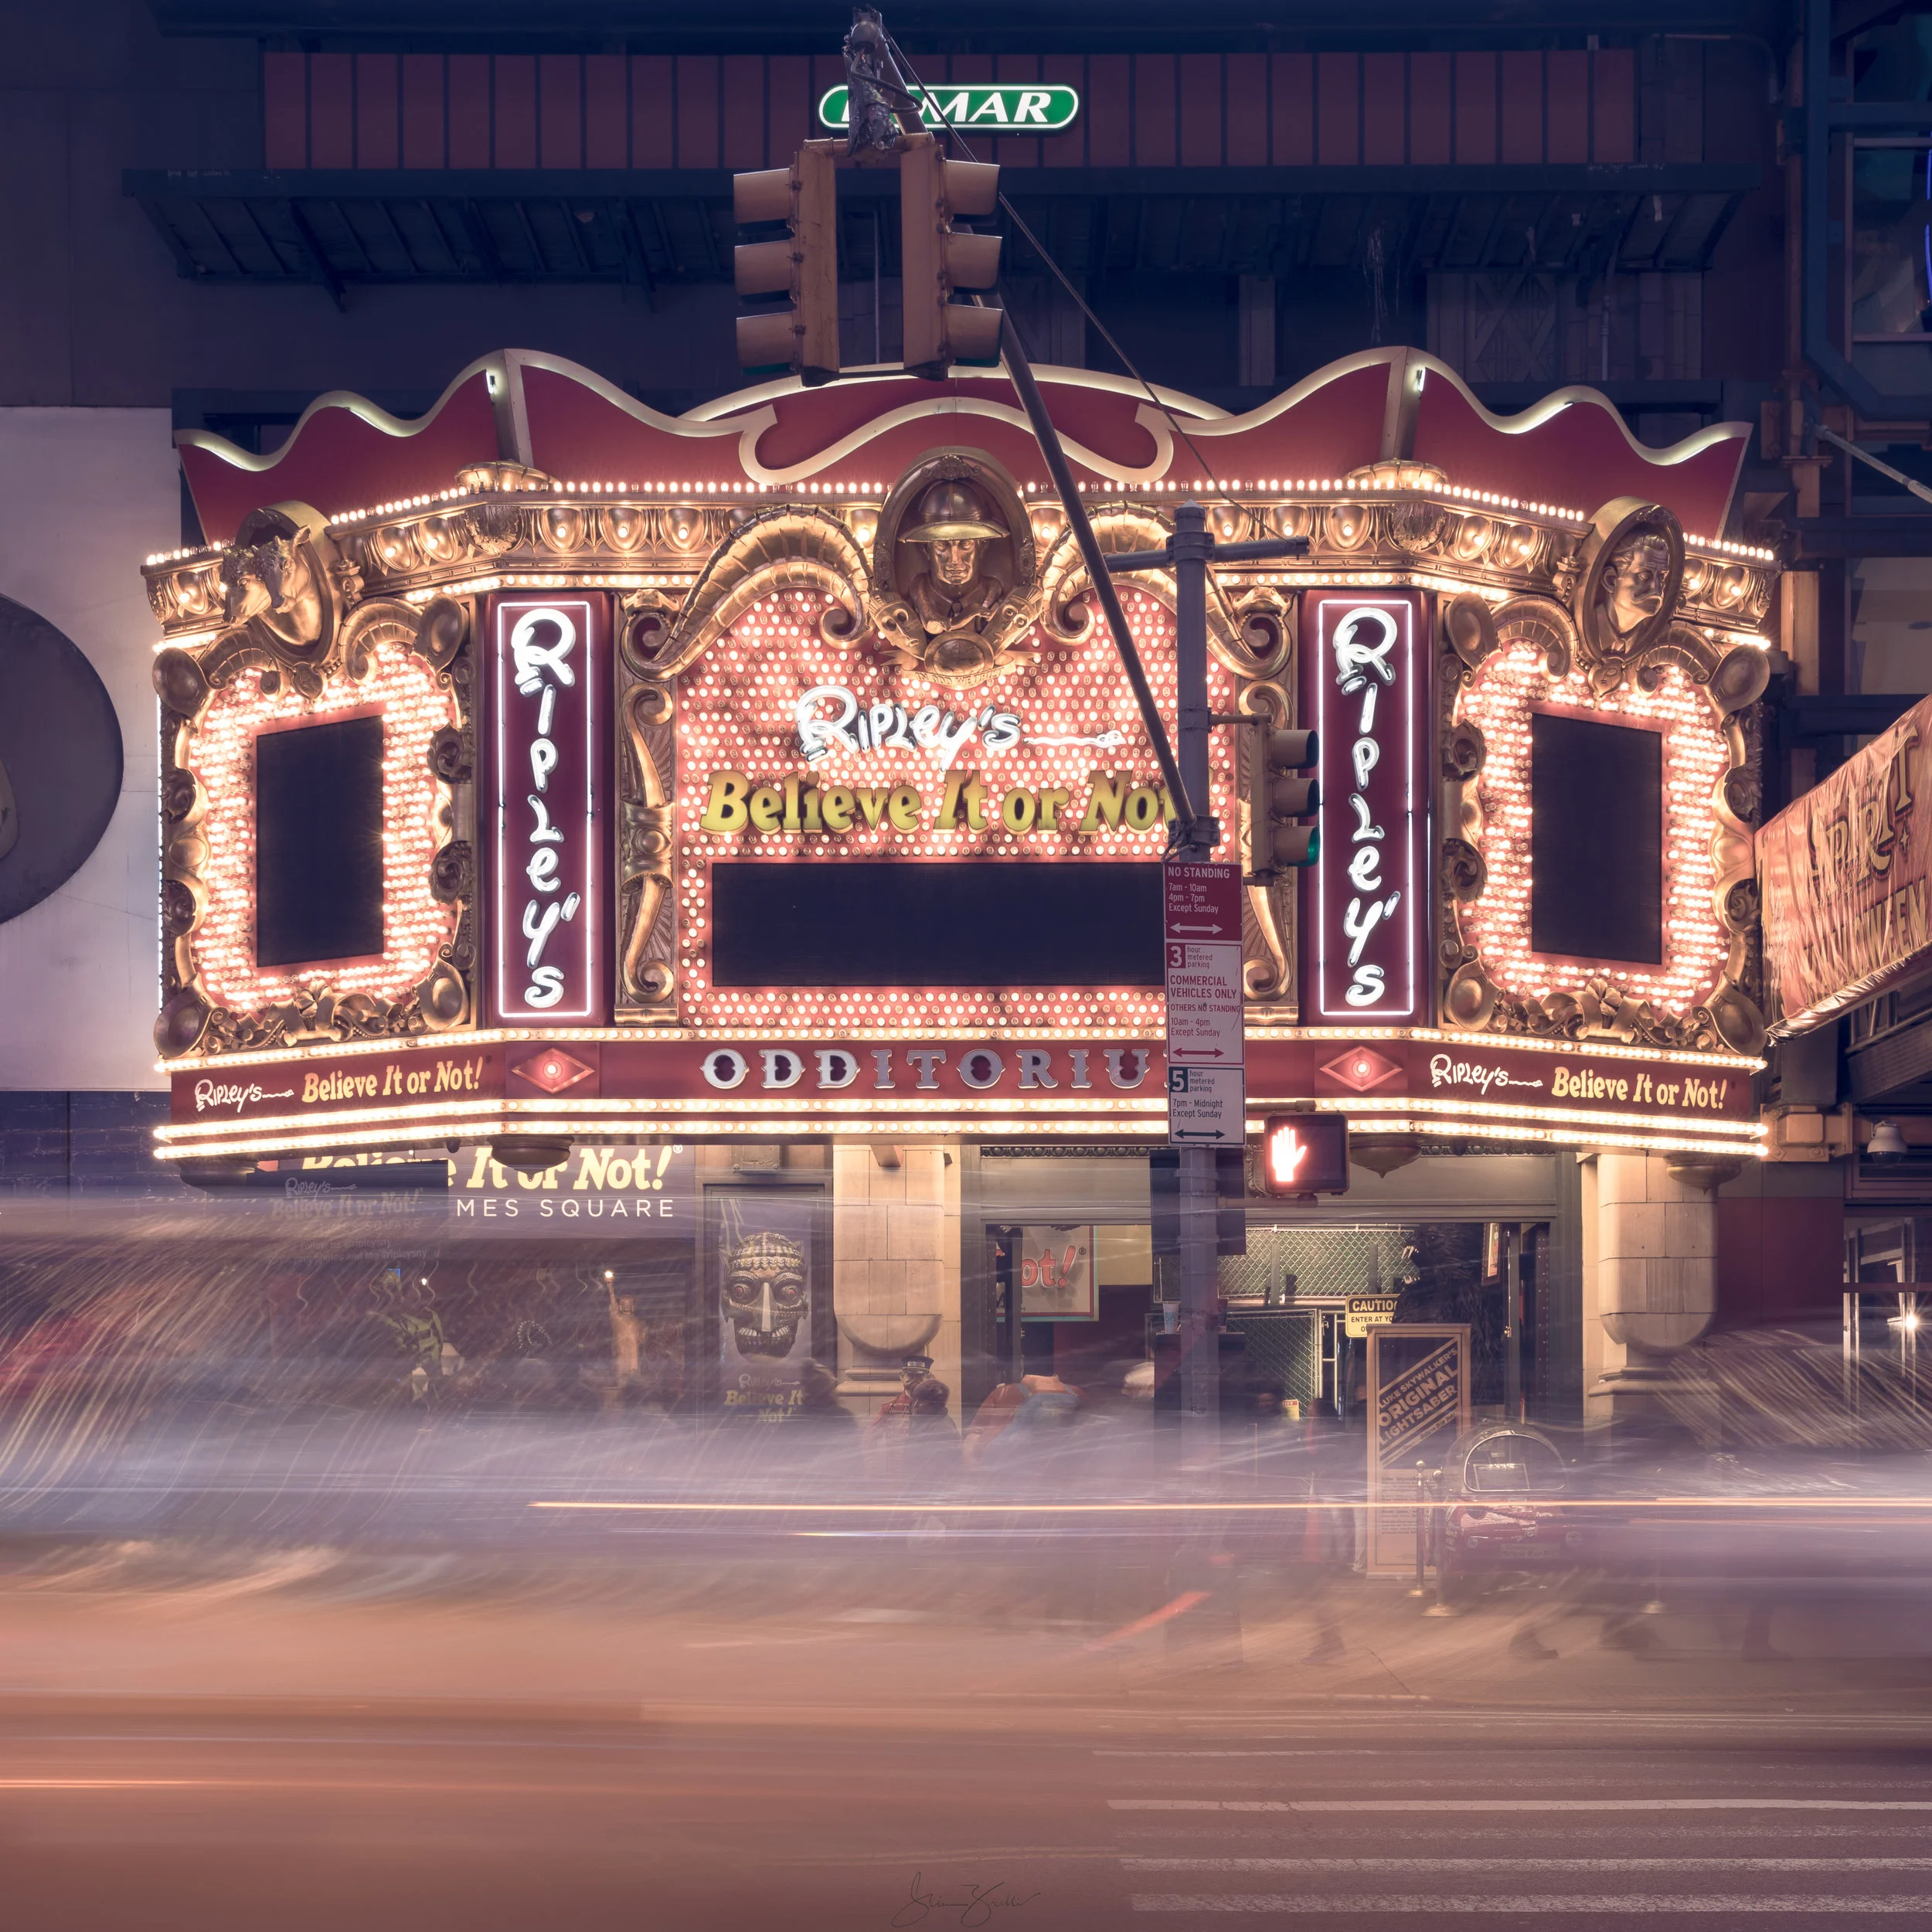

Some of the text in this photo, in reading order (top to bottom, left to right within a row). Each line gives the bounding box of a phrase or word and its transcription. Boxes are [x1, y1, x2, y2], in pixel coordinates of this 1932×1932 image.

[842, 91, 1051, 122] MAR
[794, 685, 1022, 773] Ripley's
[511, 608, 580, 1009] Ripley's
[699, 770, 1177, 833] Believe It or No
[1332, 607, 1402, 1007] Ripley's
[1168, 866, 1230, 879] NO STANDING
[1168, 883, 1182, 892] 7am
[1189, 883, 1207, 893] 10am
[1168, 893, 1184, 903] 4pm
[1191, 893, 1205, 903] 7pm
[1168, 903, 1219, 914] Except Sunday
[1170, 945, 1182, 967] 3
[1187, 961, 1210, 969] parking
[1170, 975, 1227, 986] COMMERCIAL
[1171, 988, 1236, 998] VEHICLES ONLY
[1171, 1003, 1196, 1012] OTHERS
[1209, 1004, 1240, 1013] STANDING
[1171, 1017, 1189, 1026] 10am
[1196, 1018, 1210, 1028] 4pm
[1171, 1028, 1220, 1038] Except Sunday
[699, 1047, 1168, 1089] ODDITORIU
[194, 1056, 483, 1114] Ripley's Believe It or Not!
[1172, 1070, 1184, 1092] 5
[1189, 1084, 1212, 1093] parking
[1430, 1053, 1728, 1110] Ripley's Believe It or Not!
[1172, 1098, 1187, 1108] 7pm
[1194, 1099, 1223, 1110] Midnight
[1172, 1109, 1222, 1119] Except Sunday
[573, 1145, 672, 1191] Not!
[456, 1199, 674, 1217] MES SQUARE
[1021, 1245, 1077, 1287] ot!
[1379, 1347, 1458, 1409] LUKE SKYWALKER'S
[1379, 1365, 1458, 1426] ORIGINAL
[1379, 1384, 1457, 1445] LIGHTSABER
